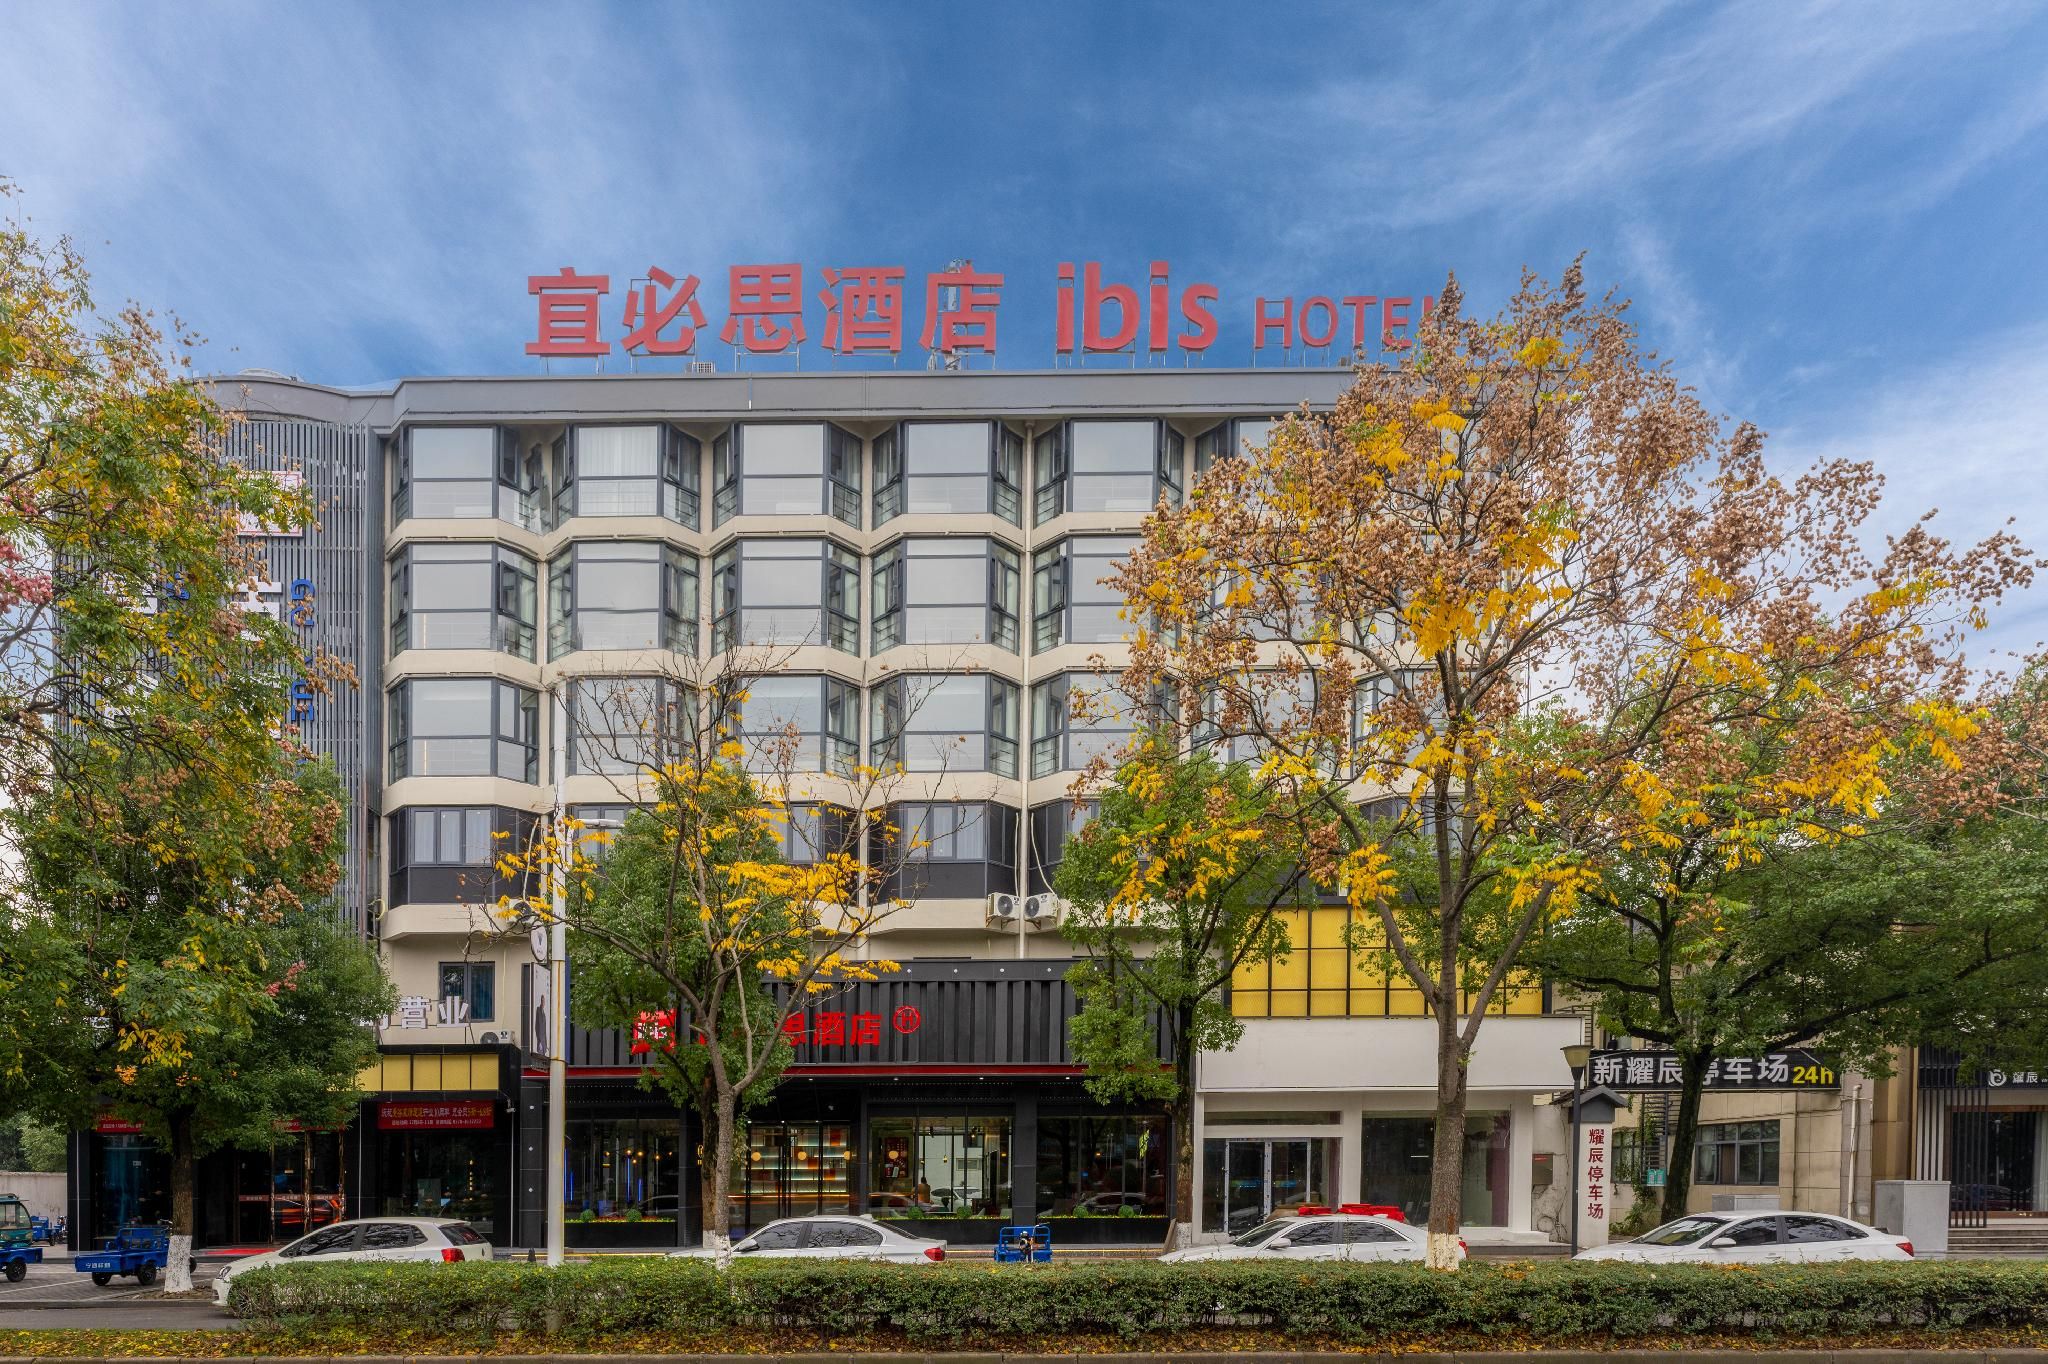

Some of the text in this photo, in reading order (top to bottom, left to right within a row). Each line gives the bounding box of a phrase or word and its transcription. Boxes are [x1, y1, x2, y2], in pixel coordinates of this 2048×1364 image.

[525, 263, 1004, 355] 宜必思酒店
[1056, 261, 1218, 353] ibis
[1792, 1065, 1834, 1085] 24h
[1586, 1128, 1605, 1220] 耀辰停车场
